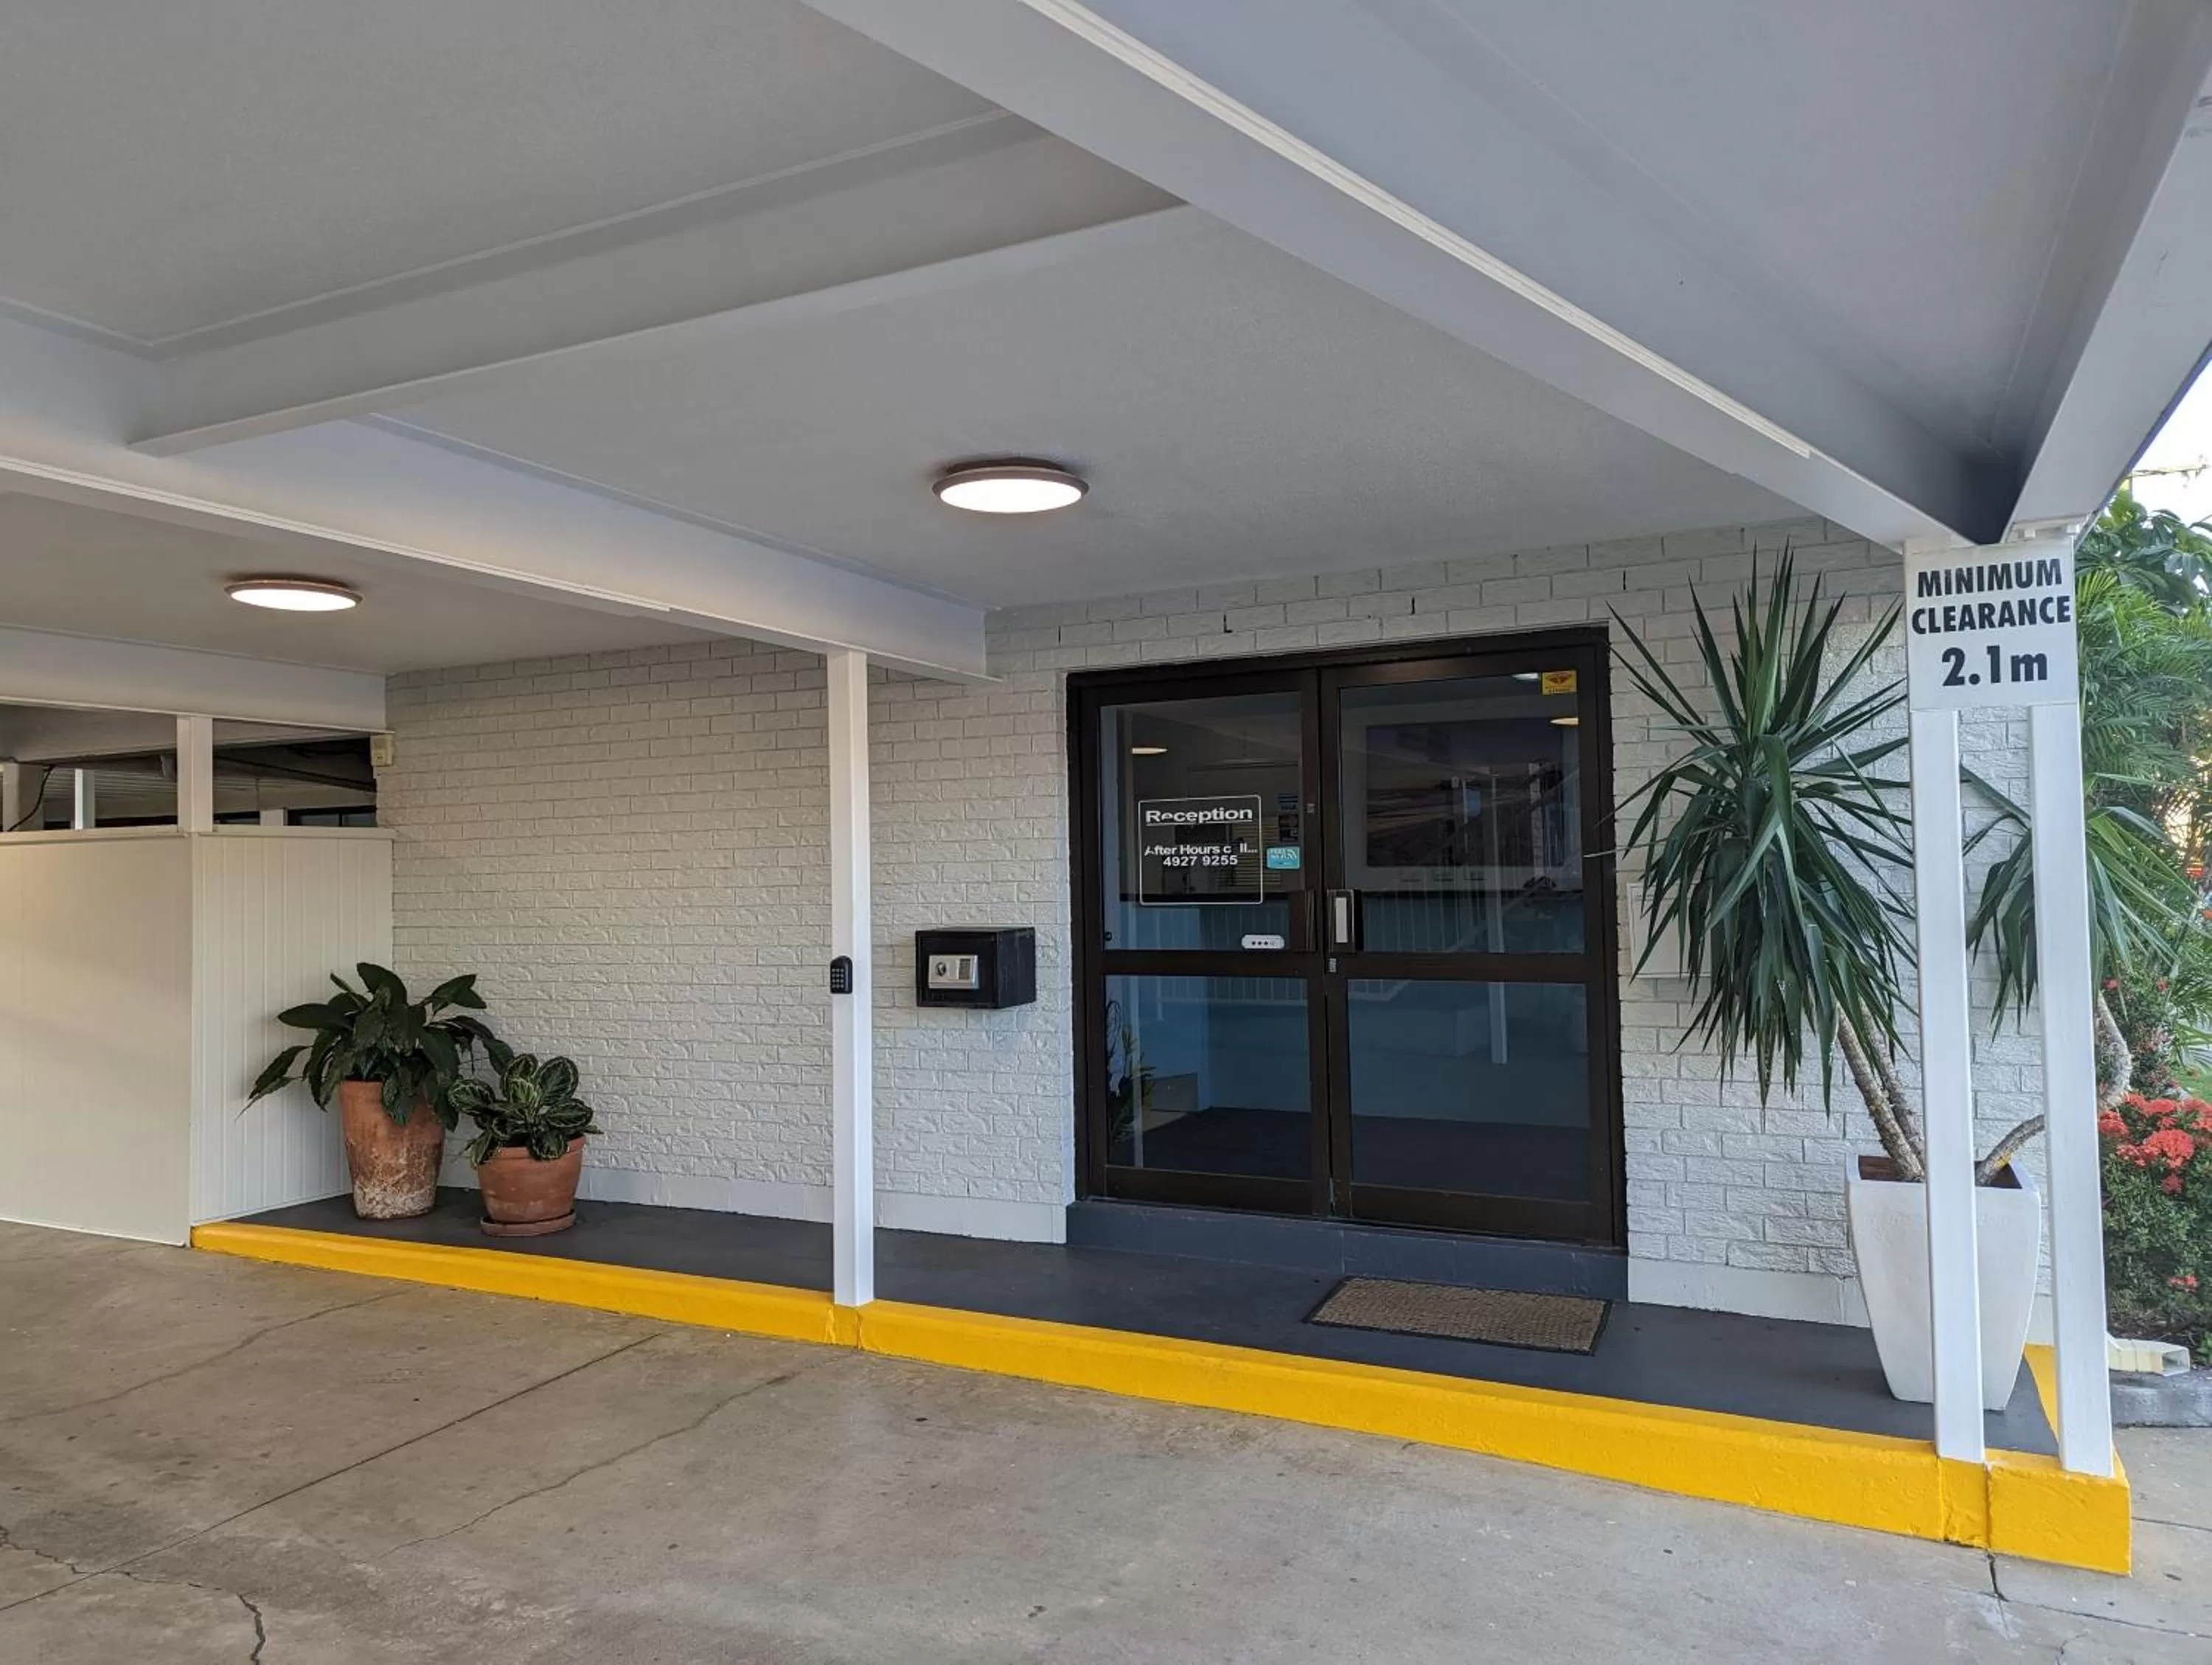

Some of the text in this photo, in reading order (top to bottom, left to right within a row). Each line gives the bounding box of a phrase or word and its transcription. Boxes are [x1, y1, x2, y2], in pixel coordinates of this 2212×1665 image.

[1917, 558, 2062, 597] MINIMUM
[1912, 595, 2071, 634] CLEARANCE
[1941, 645, 2048, 686] 2.1m
[1146, 807, 1253, 823] Reception
[1163, 855, 1238, 866] 4927 9255
[1180, 844, 1220, 855] Hours
